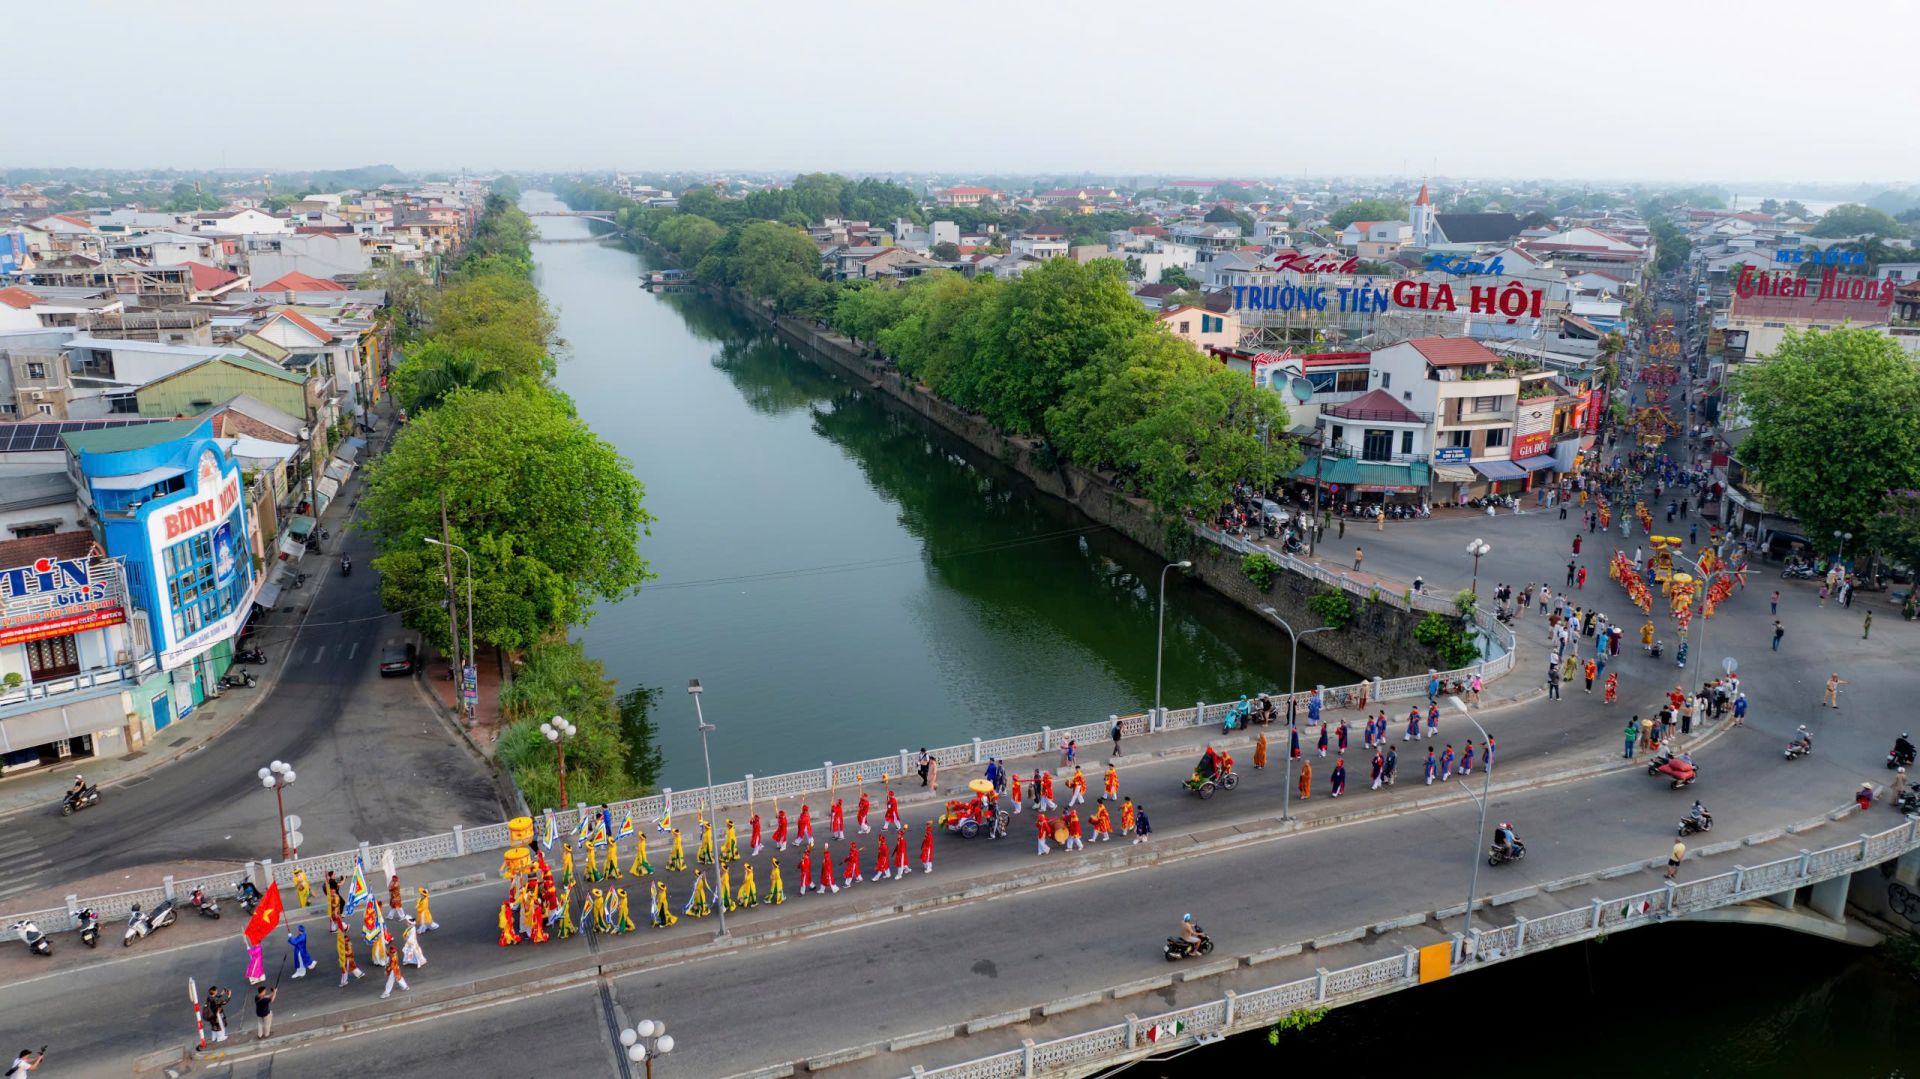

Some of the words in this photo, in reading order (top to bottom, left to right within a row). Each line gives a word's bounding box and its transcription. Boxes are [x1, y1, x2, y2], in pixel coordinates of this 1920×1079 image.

[1273, 253, 1360, 274] Kính
[1424, 252, 1505, 276] Kính
[1232, 279, 1328, 312] TRƯỜNG
[1337, 277, 1389, 313] TIỀN
[1393, 280, 1457, 312] GIA
[1470, 280, 1543, 325] HỘI
[1736, 264, 1808, 300] Thiên
[1816, 265, 1896, 308] Hương
[164, 498, 216, 540] BÌNH
